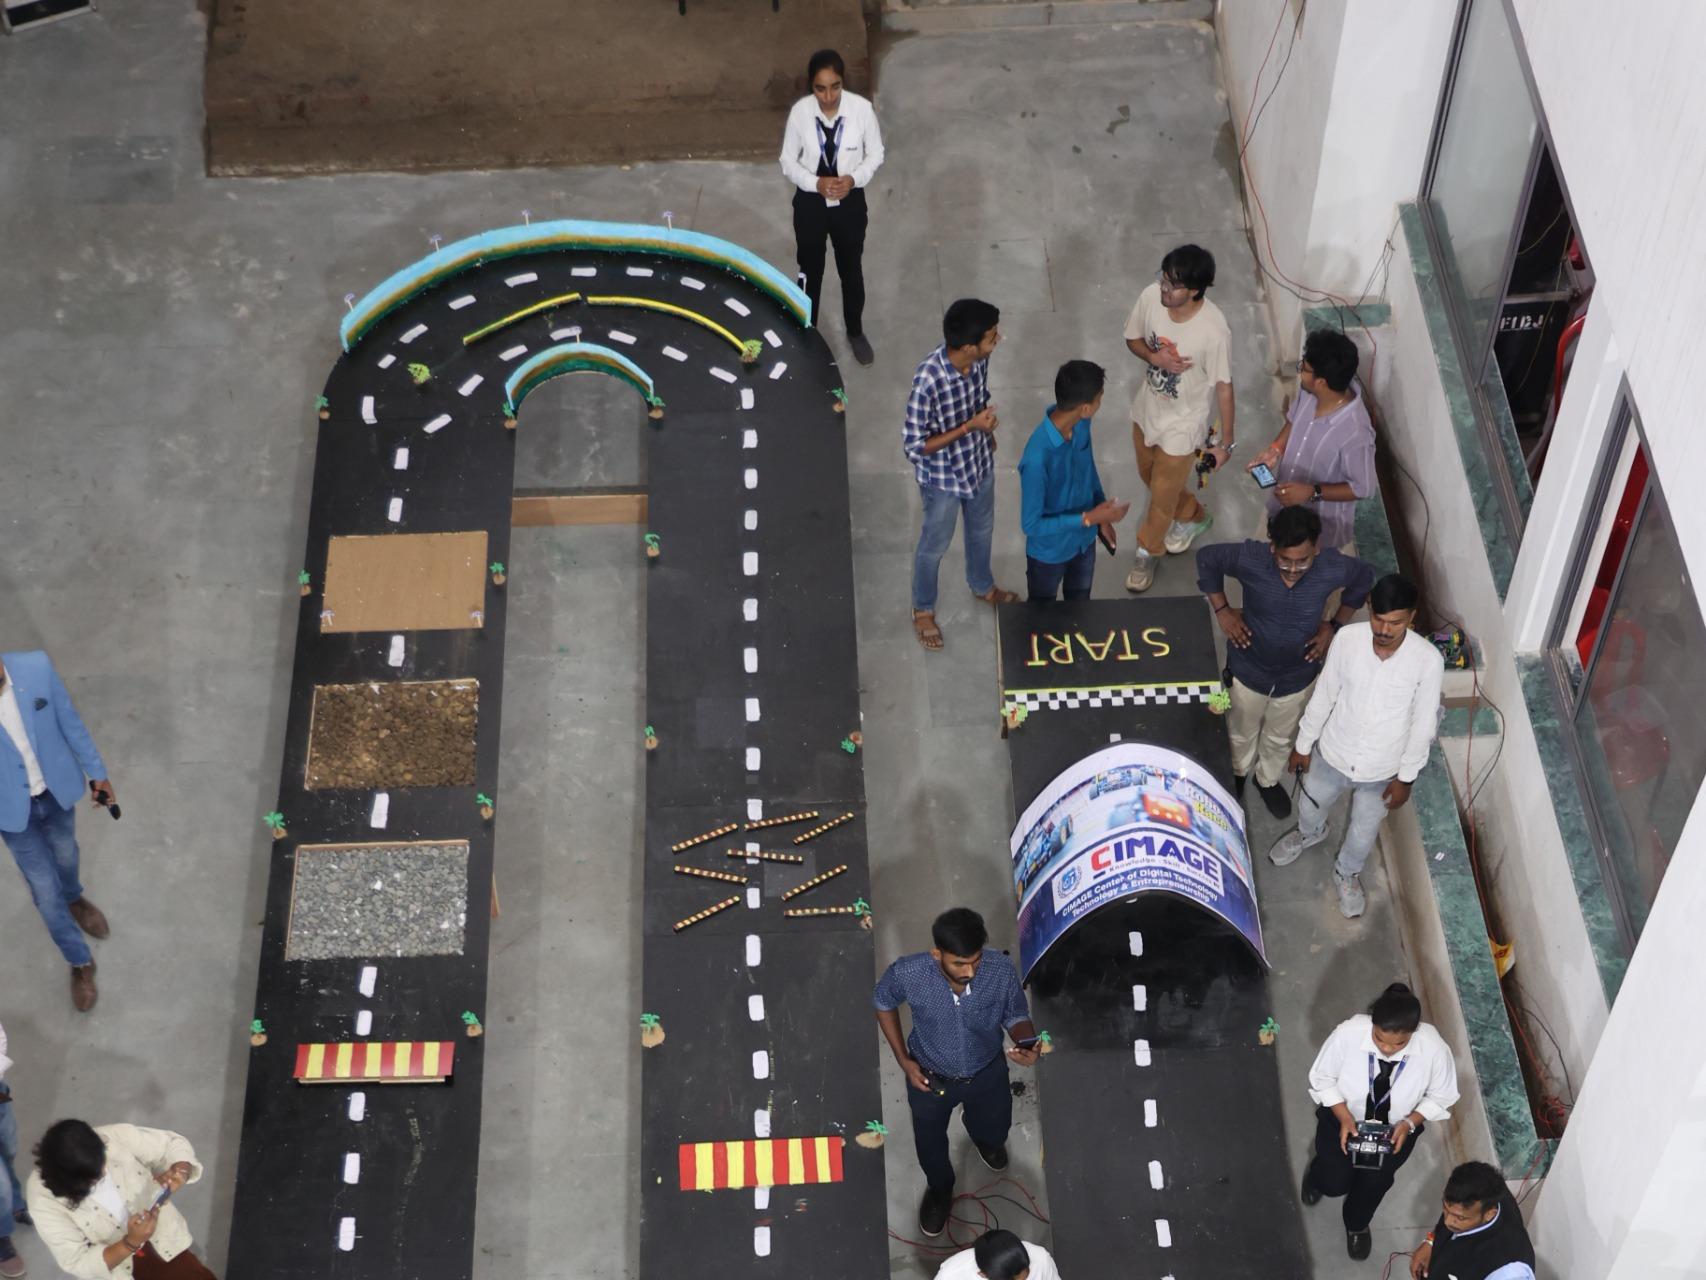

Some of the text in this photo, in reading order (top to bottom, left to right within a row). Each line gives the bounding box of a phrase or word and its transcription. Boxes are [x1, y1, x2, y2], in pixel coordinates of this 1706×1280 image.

[1024, 626, 1170, 666] START
[1091, 836, 1219, 882] CIMAGE
[1062, 889, 1093, 917] CIMAGE
[1094, 876, 1124, 894] Center
[1127, 870, 1137, 881] of
[1140, 868, 1172, 879] Digital
[1173, 872, 1217, 901] Technology
[1072, 888, 1119, 917] Technology
[1121, 882, 1129, 891] &
